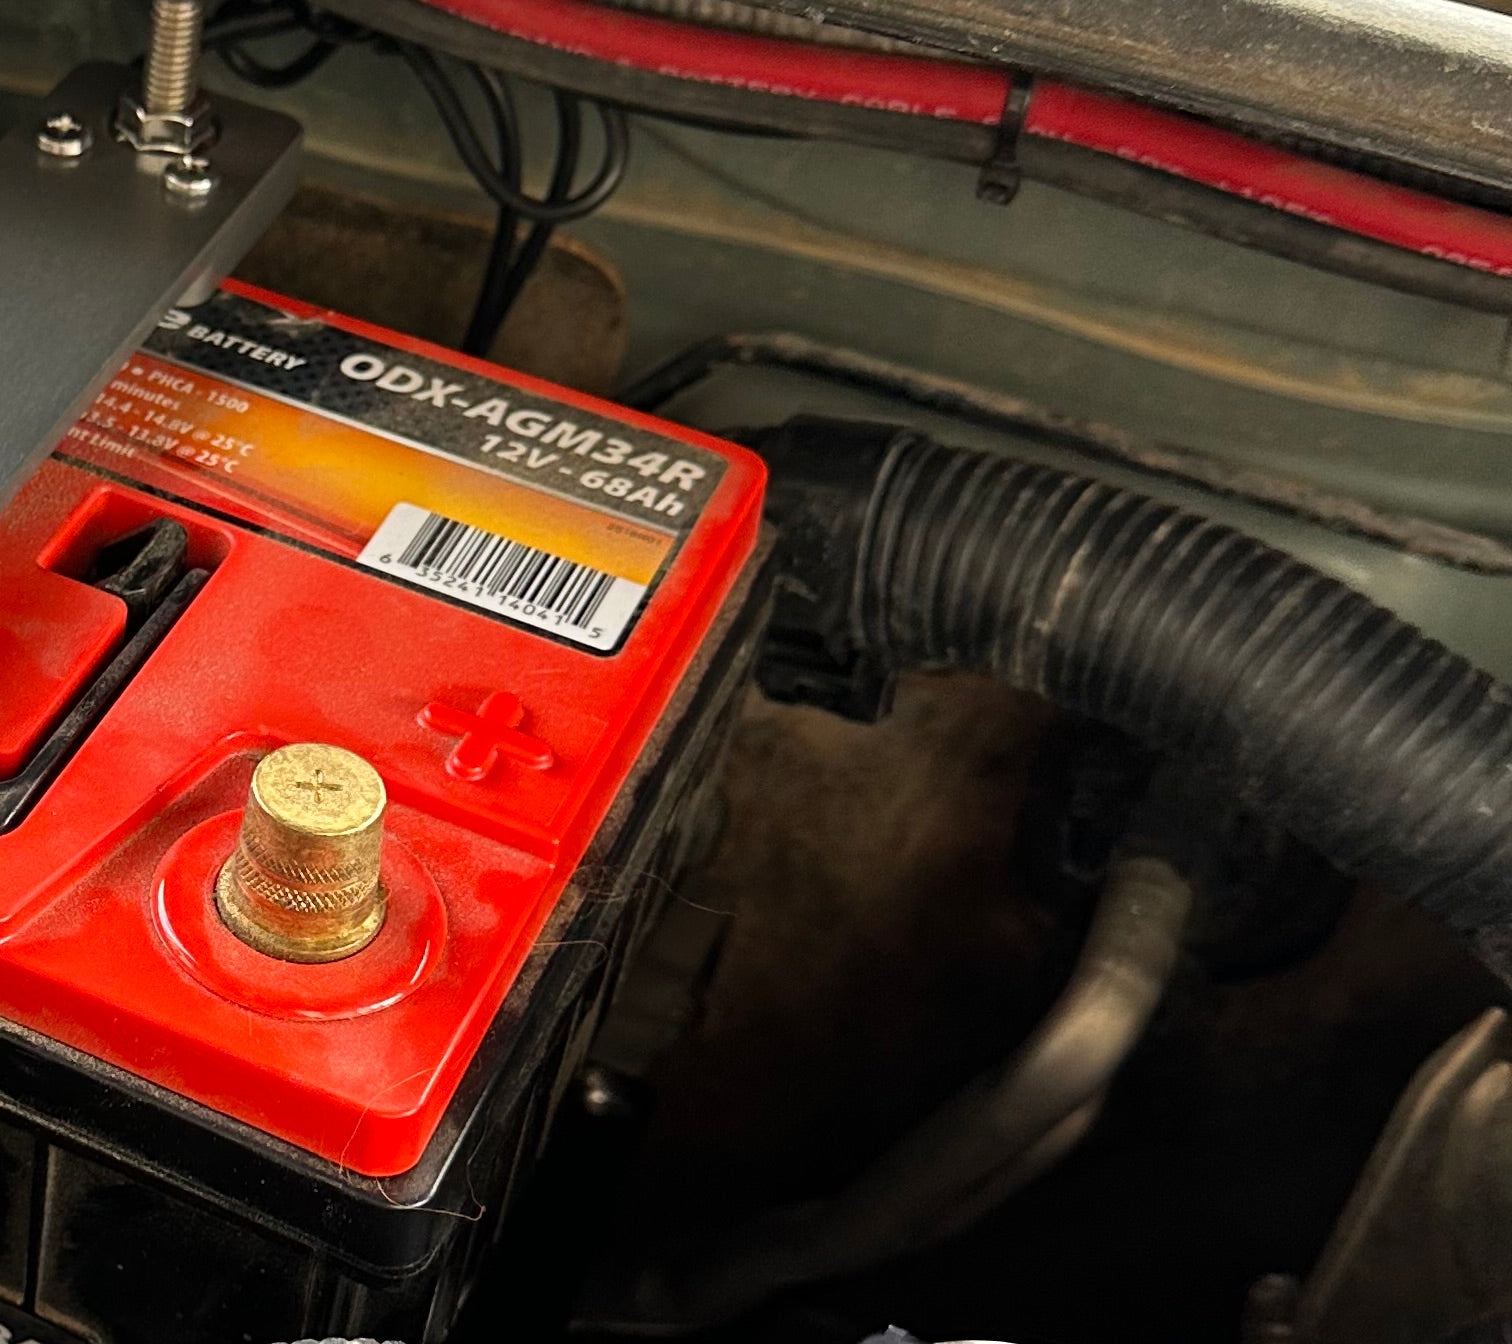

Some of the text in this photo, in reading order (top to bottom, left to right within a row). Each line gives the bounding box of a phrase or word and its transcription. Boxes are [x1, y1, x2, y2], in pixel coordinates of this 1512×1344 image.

[187, 323, 307, 372] BATTERY
[110, 378, 182, 412] minutes
[147, 369, 196, 396] PHCA
[206, 387, 250, 415] 1500
[338, 352, 707, 492] ODX-AGM34R
[479, 433, 560, 471] 12V
[579, 469, 686, 518] 68Ah
[379, 552, 603, 639] 6 35241 14041 5
